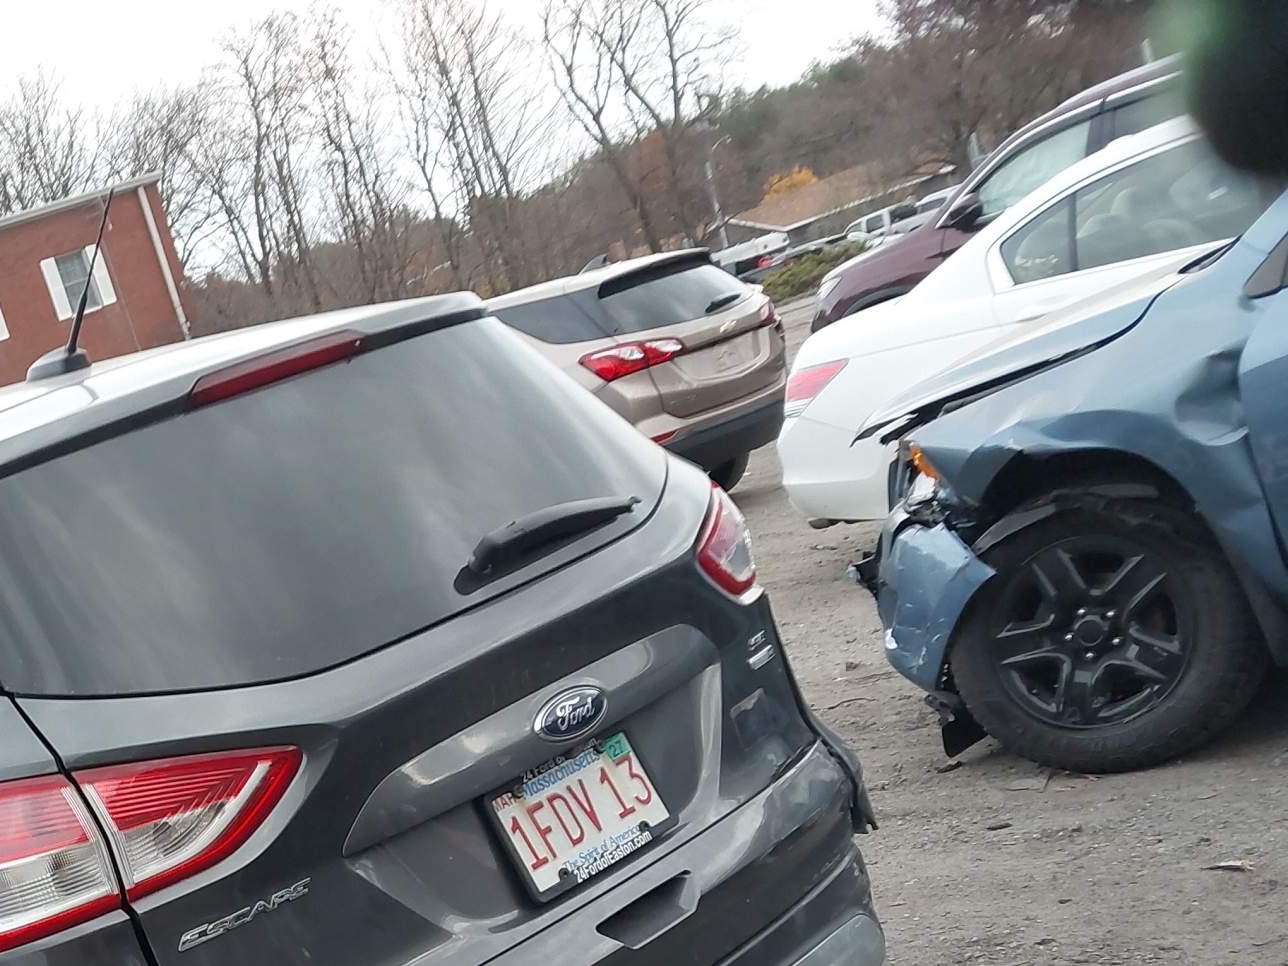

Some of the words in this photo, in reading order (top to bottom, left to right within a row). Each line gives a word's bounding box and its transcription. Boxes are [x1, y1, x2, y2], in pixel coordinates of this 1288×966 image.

[556, 696, 596, 731] Ford
[510, 778, 603, 871] 1FDV
[599, 755, 652, 819] 13
[178, 877, 312, 952] ESCAPE
